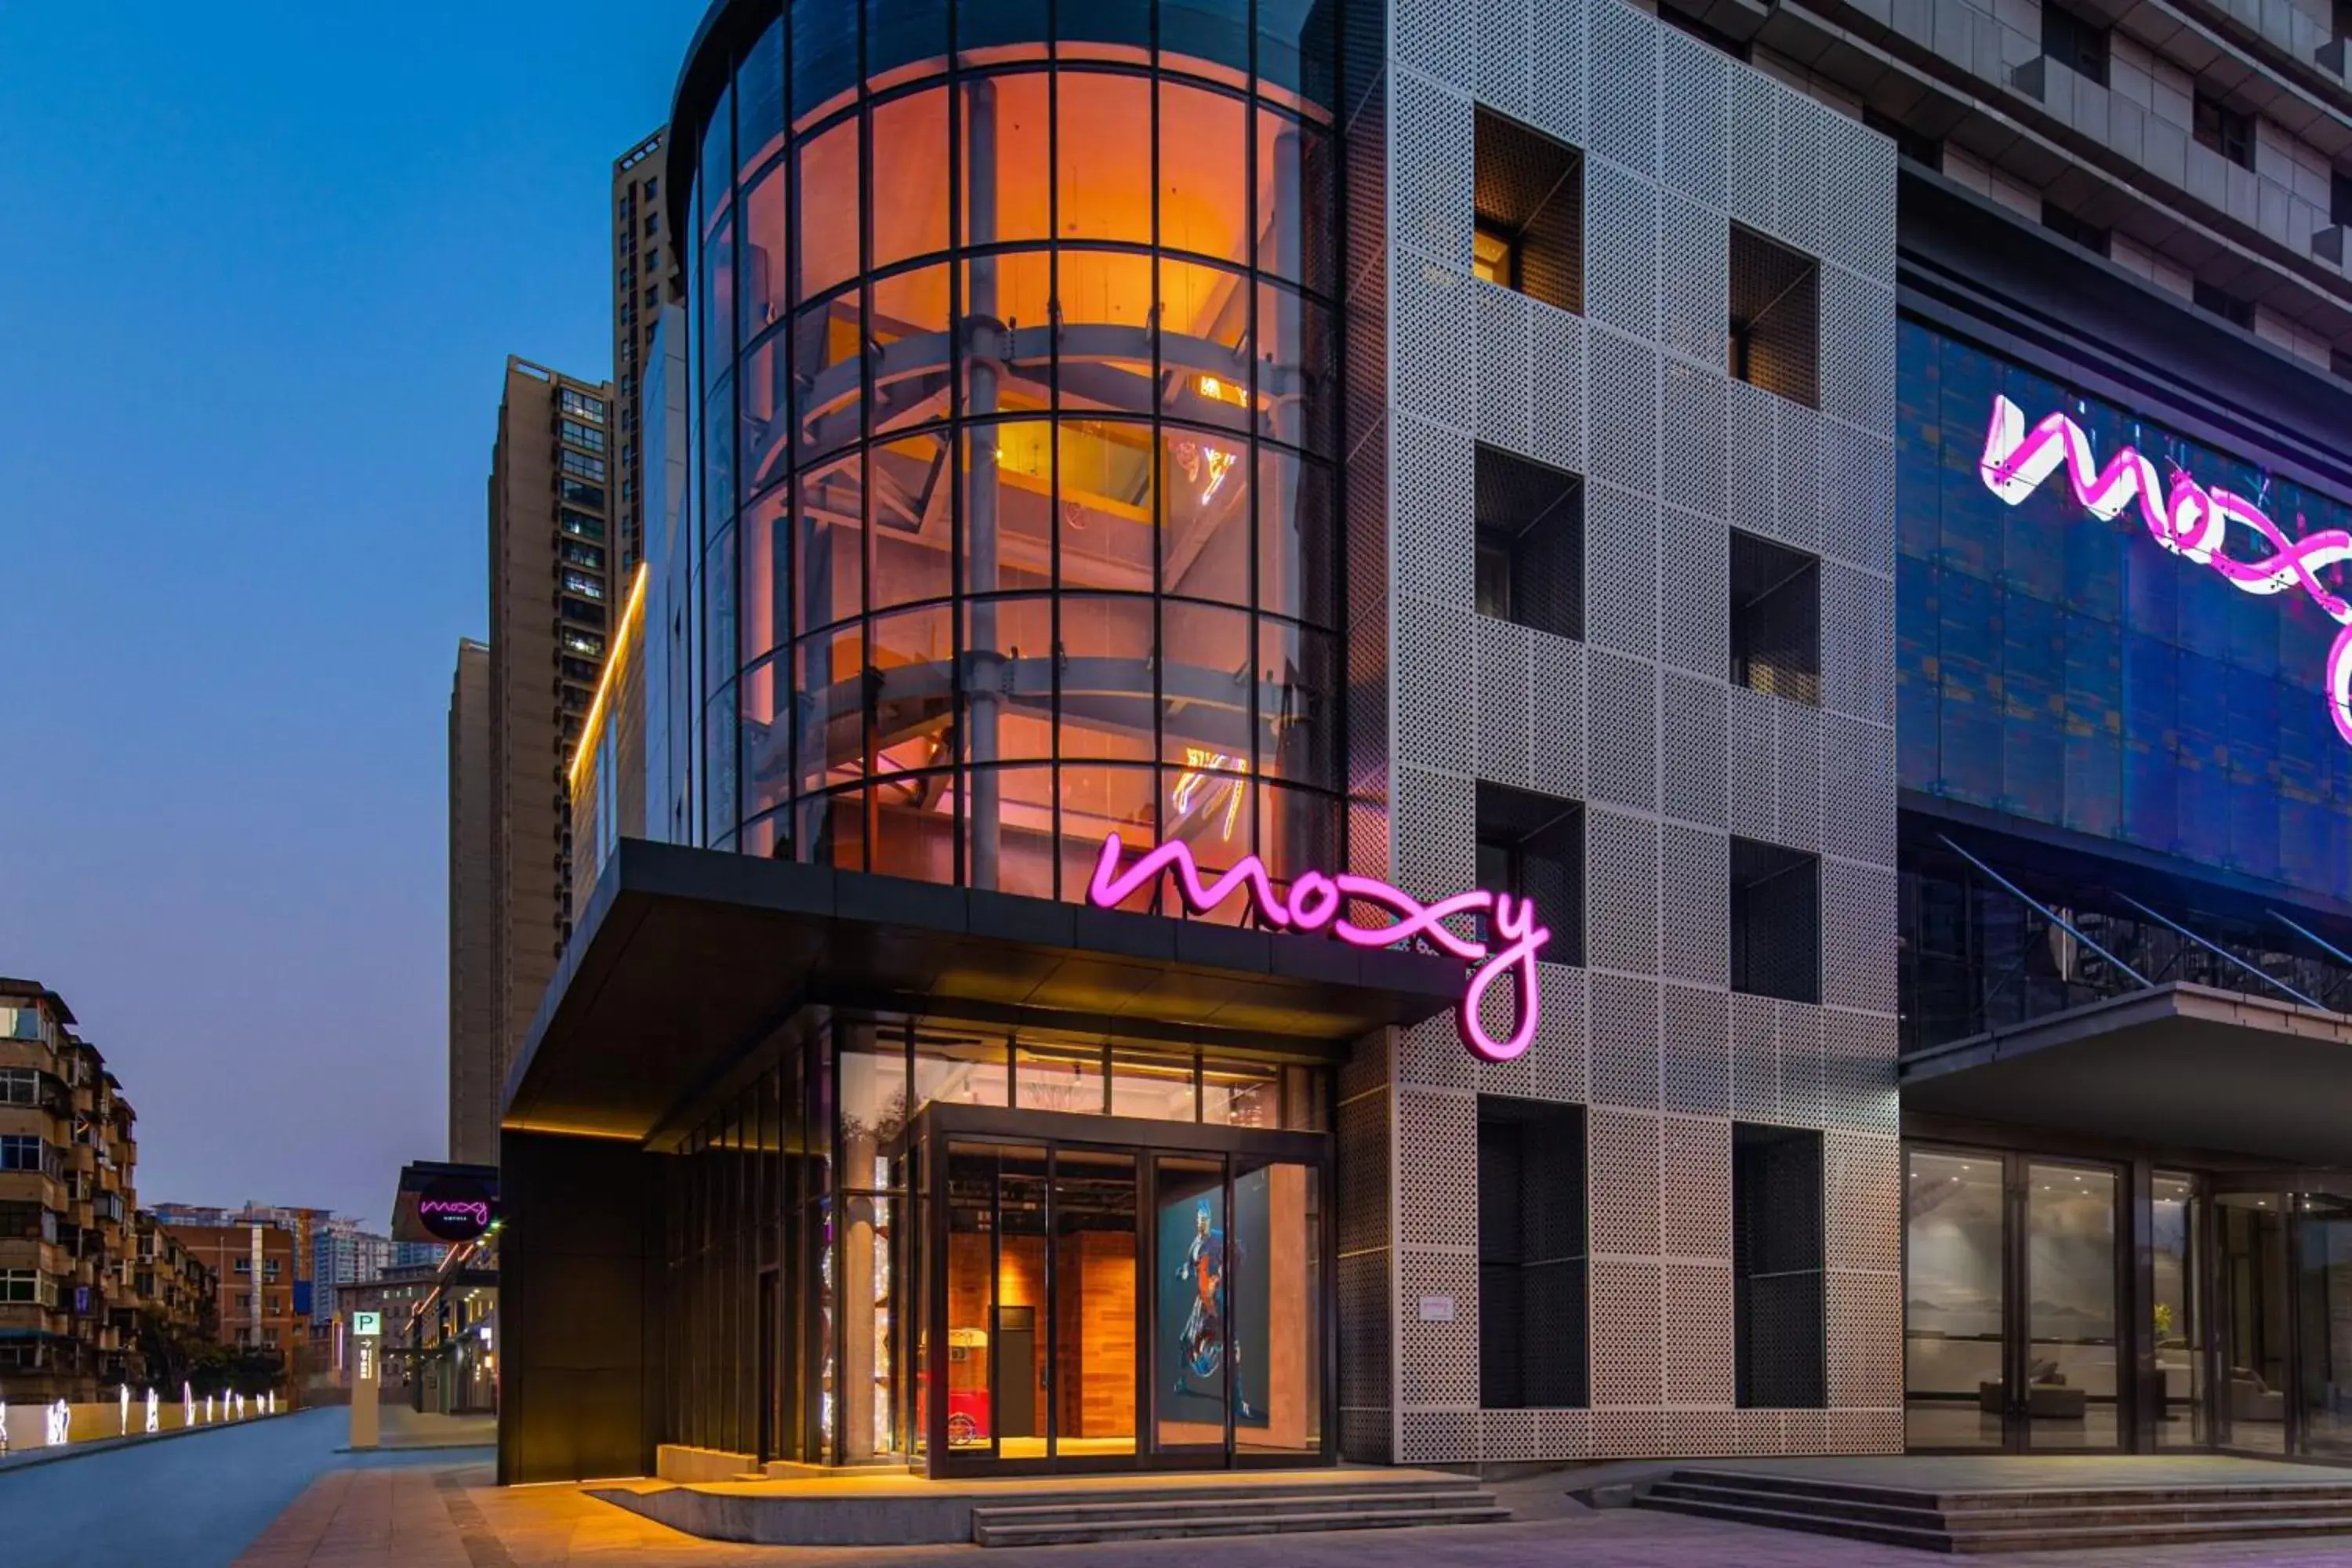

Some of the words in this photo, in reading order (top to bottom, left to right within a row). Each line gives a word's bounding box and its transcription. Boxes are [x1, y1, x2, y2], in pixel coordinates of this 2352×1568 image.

[1087, 832, 1552, 1062] moxy
[420, 1200, 488, 1225] moxy
[360, 1315, 373, 1330] P
